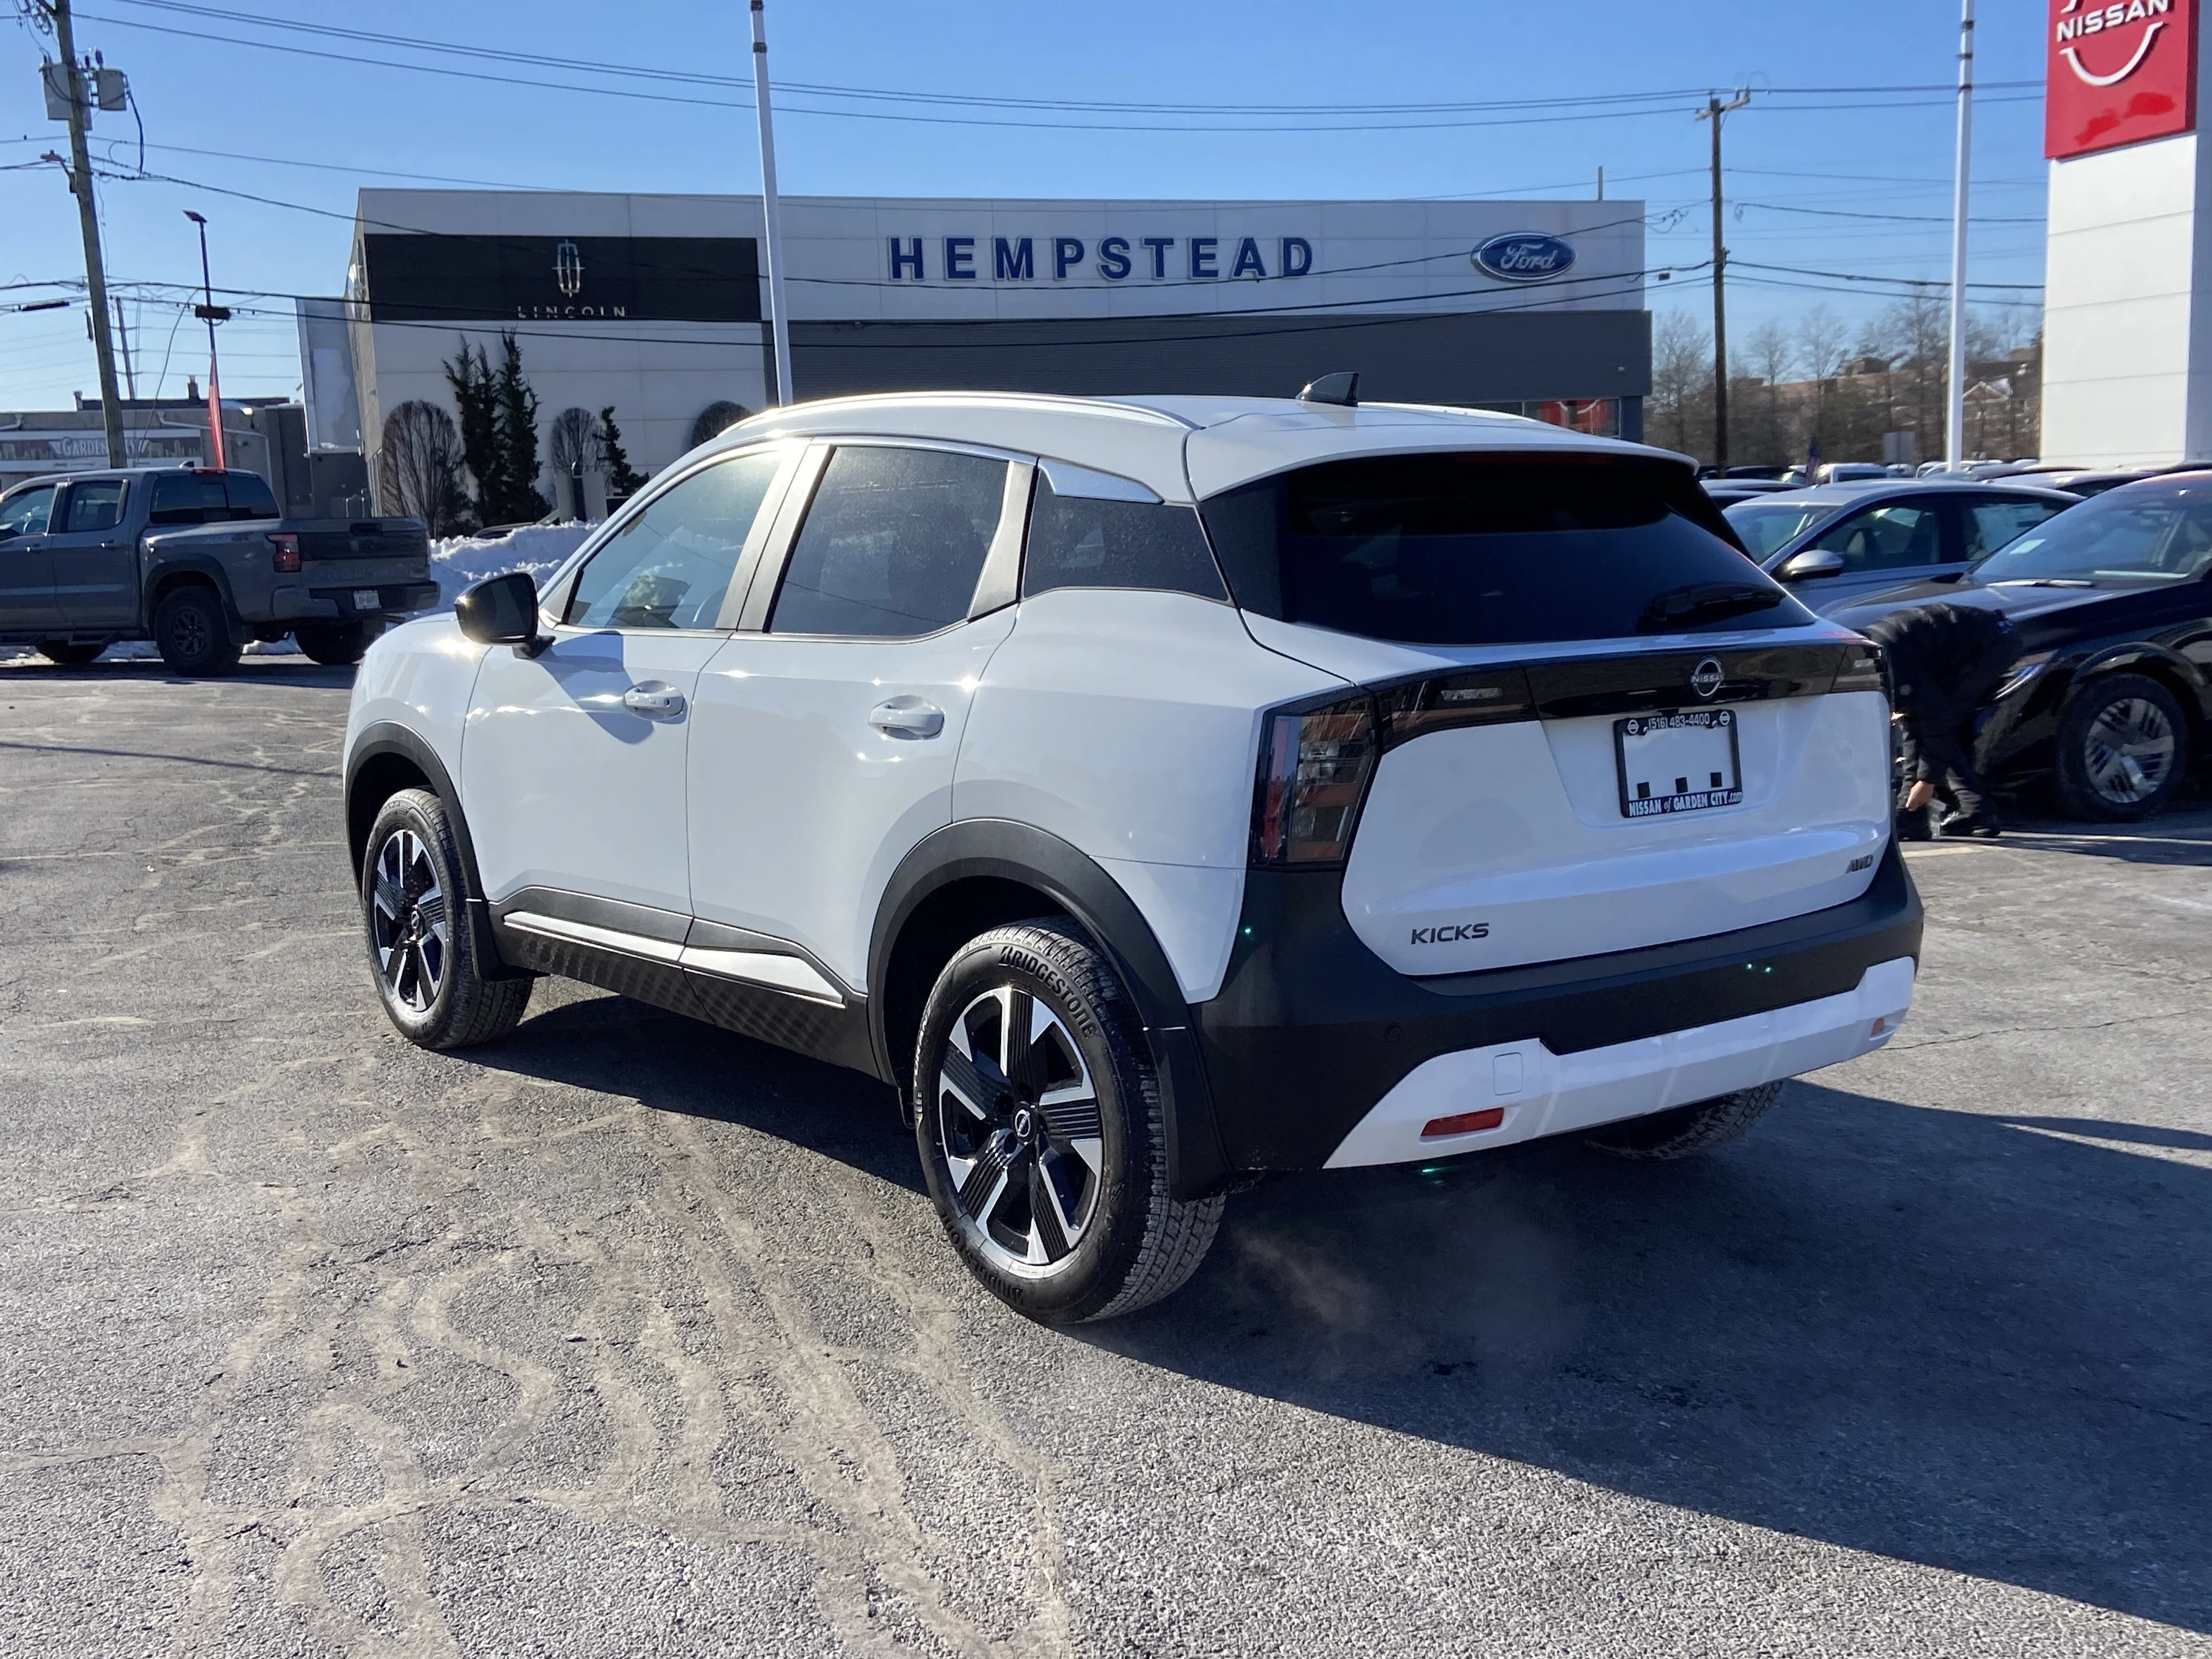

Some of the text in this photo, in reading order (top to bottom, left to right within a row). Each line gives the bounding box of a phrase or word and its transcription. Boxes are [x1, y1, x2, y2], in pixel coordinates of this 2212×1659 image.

[2056, 0, 2168, 42] NISSAN
[888, 235, 1314, 281] HEMPSTEAD
[1500, 243, 1558, 269] Ford
[518, 306, 625, 319] LINCOLN
[1648, 713, 1710, 730] (516) 483-4400
[1628, 799, 1662, 817] NISSAN
[1663, 797, 1672, 813] of
[1673, 793, 1708, 811] GARDEN
[1410, 922, 1489, 945] KICKS
